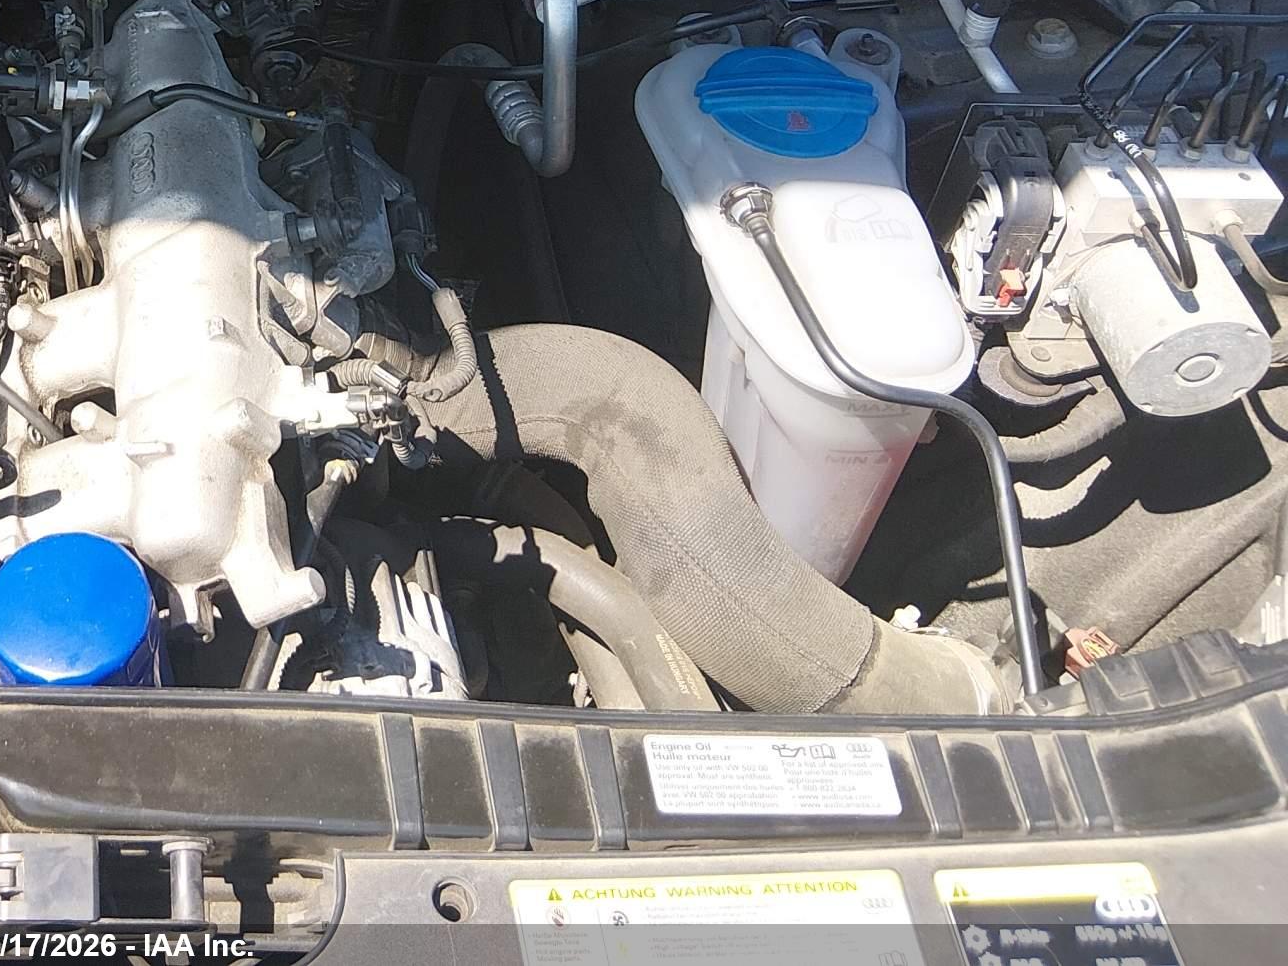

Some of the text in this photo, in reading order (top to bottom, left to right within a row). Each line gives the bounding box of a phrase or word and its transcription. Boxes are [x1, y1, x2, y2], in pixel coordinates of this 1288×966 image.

[847, 402, 897, 413] MAX
[656, 634, 672, 654] MADE
[668, 661, 690, 694] HUNGARY
[651, 741, 711, 751] Engine Oil
[653, 752, 731, 761] Huile moteur
[572, 881, 858, 900] ACHTUNG WARNING ATTENTION
